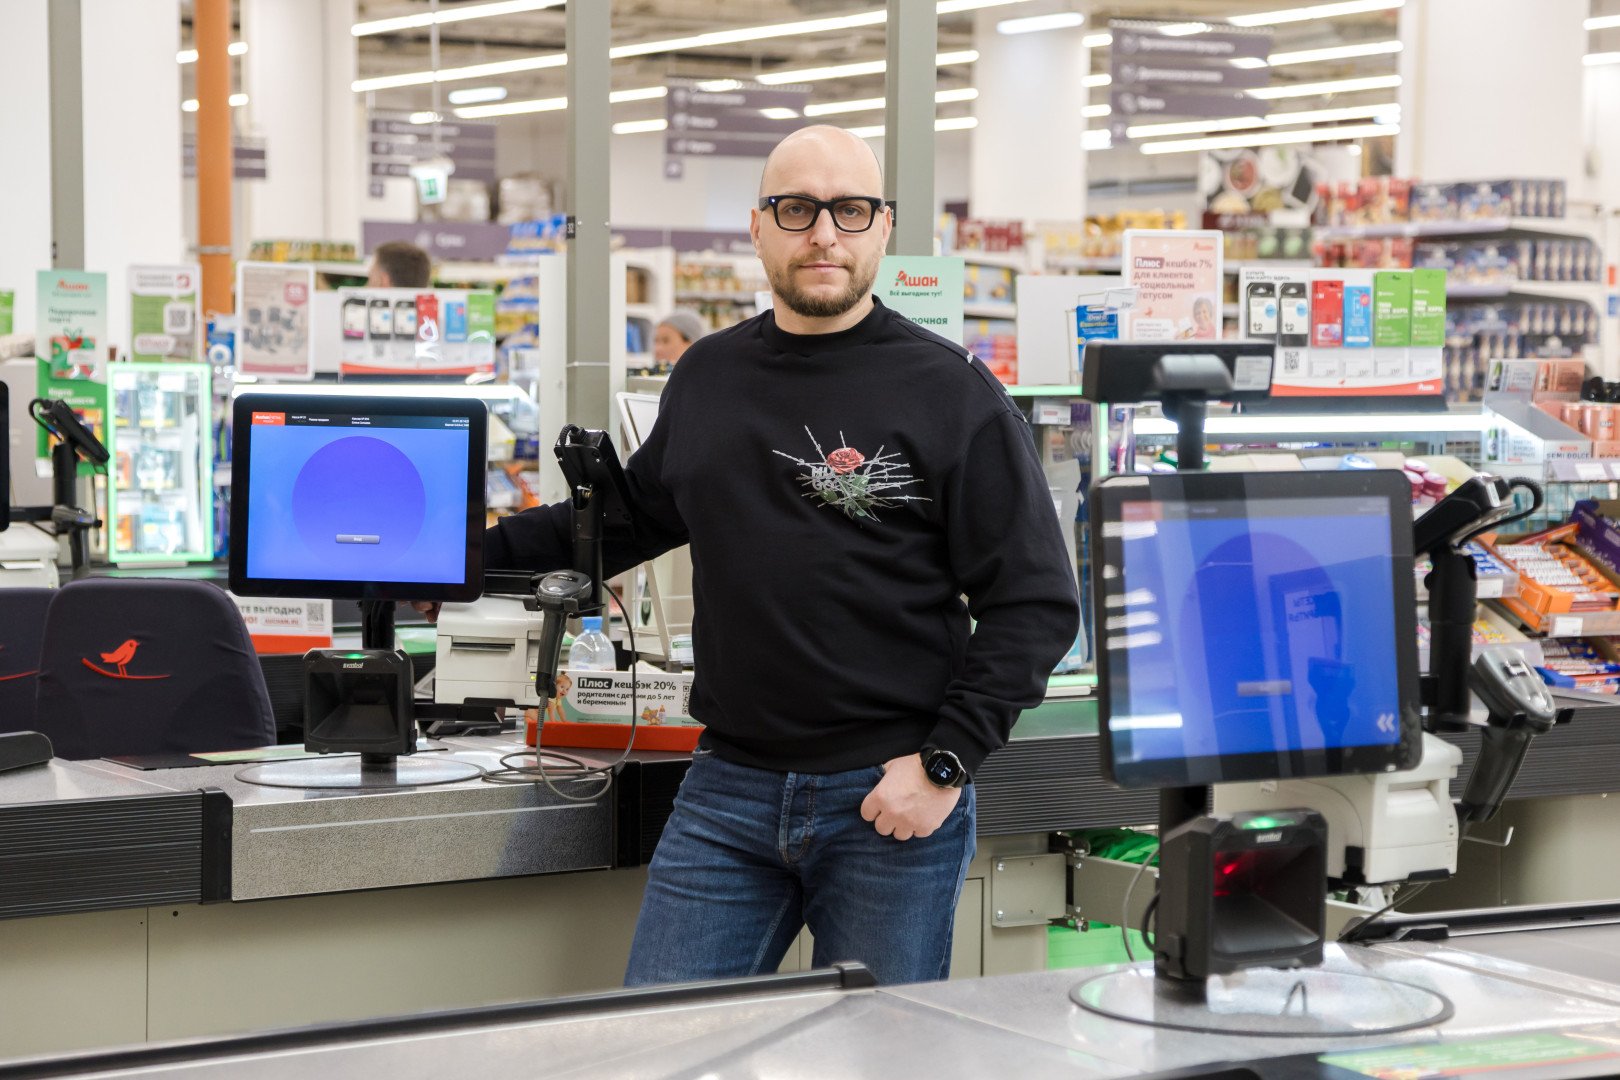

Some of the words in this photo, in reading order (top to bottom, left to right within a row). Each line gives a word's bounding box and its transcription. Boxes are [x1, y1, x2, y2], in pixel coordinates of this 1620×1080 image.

[1135, 258, 1161, 269] Плюс
[1166, 259, 1197, 269] кешбэк
[1199, 259, 1213, 269] 7%
[895, 270, 939, 287] Ашан
[1134, 272, 1151, 280] для
[1253, 323, 1263, 331] t2
[1285, 323, 1295, 332] t2
[254, 606, 302, 616] ВЫГОДНО
[579, 678, 610, 690] Плюс
[614, 680, 652, 690] кешбэк
[653, 681, 677, 691] 20%
[577, 691, 616, 699] родителям
